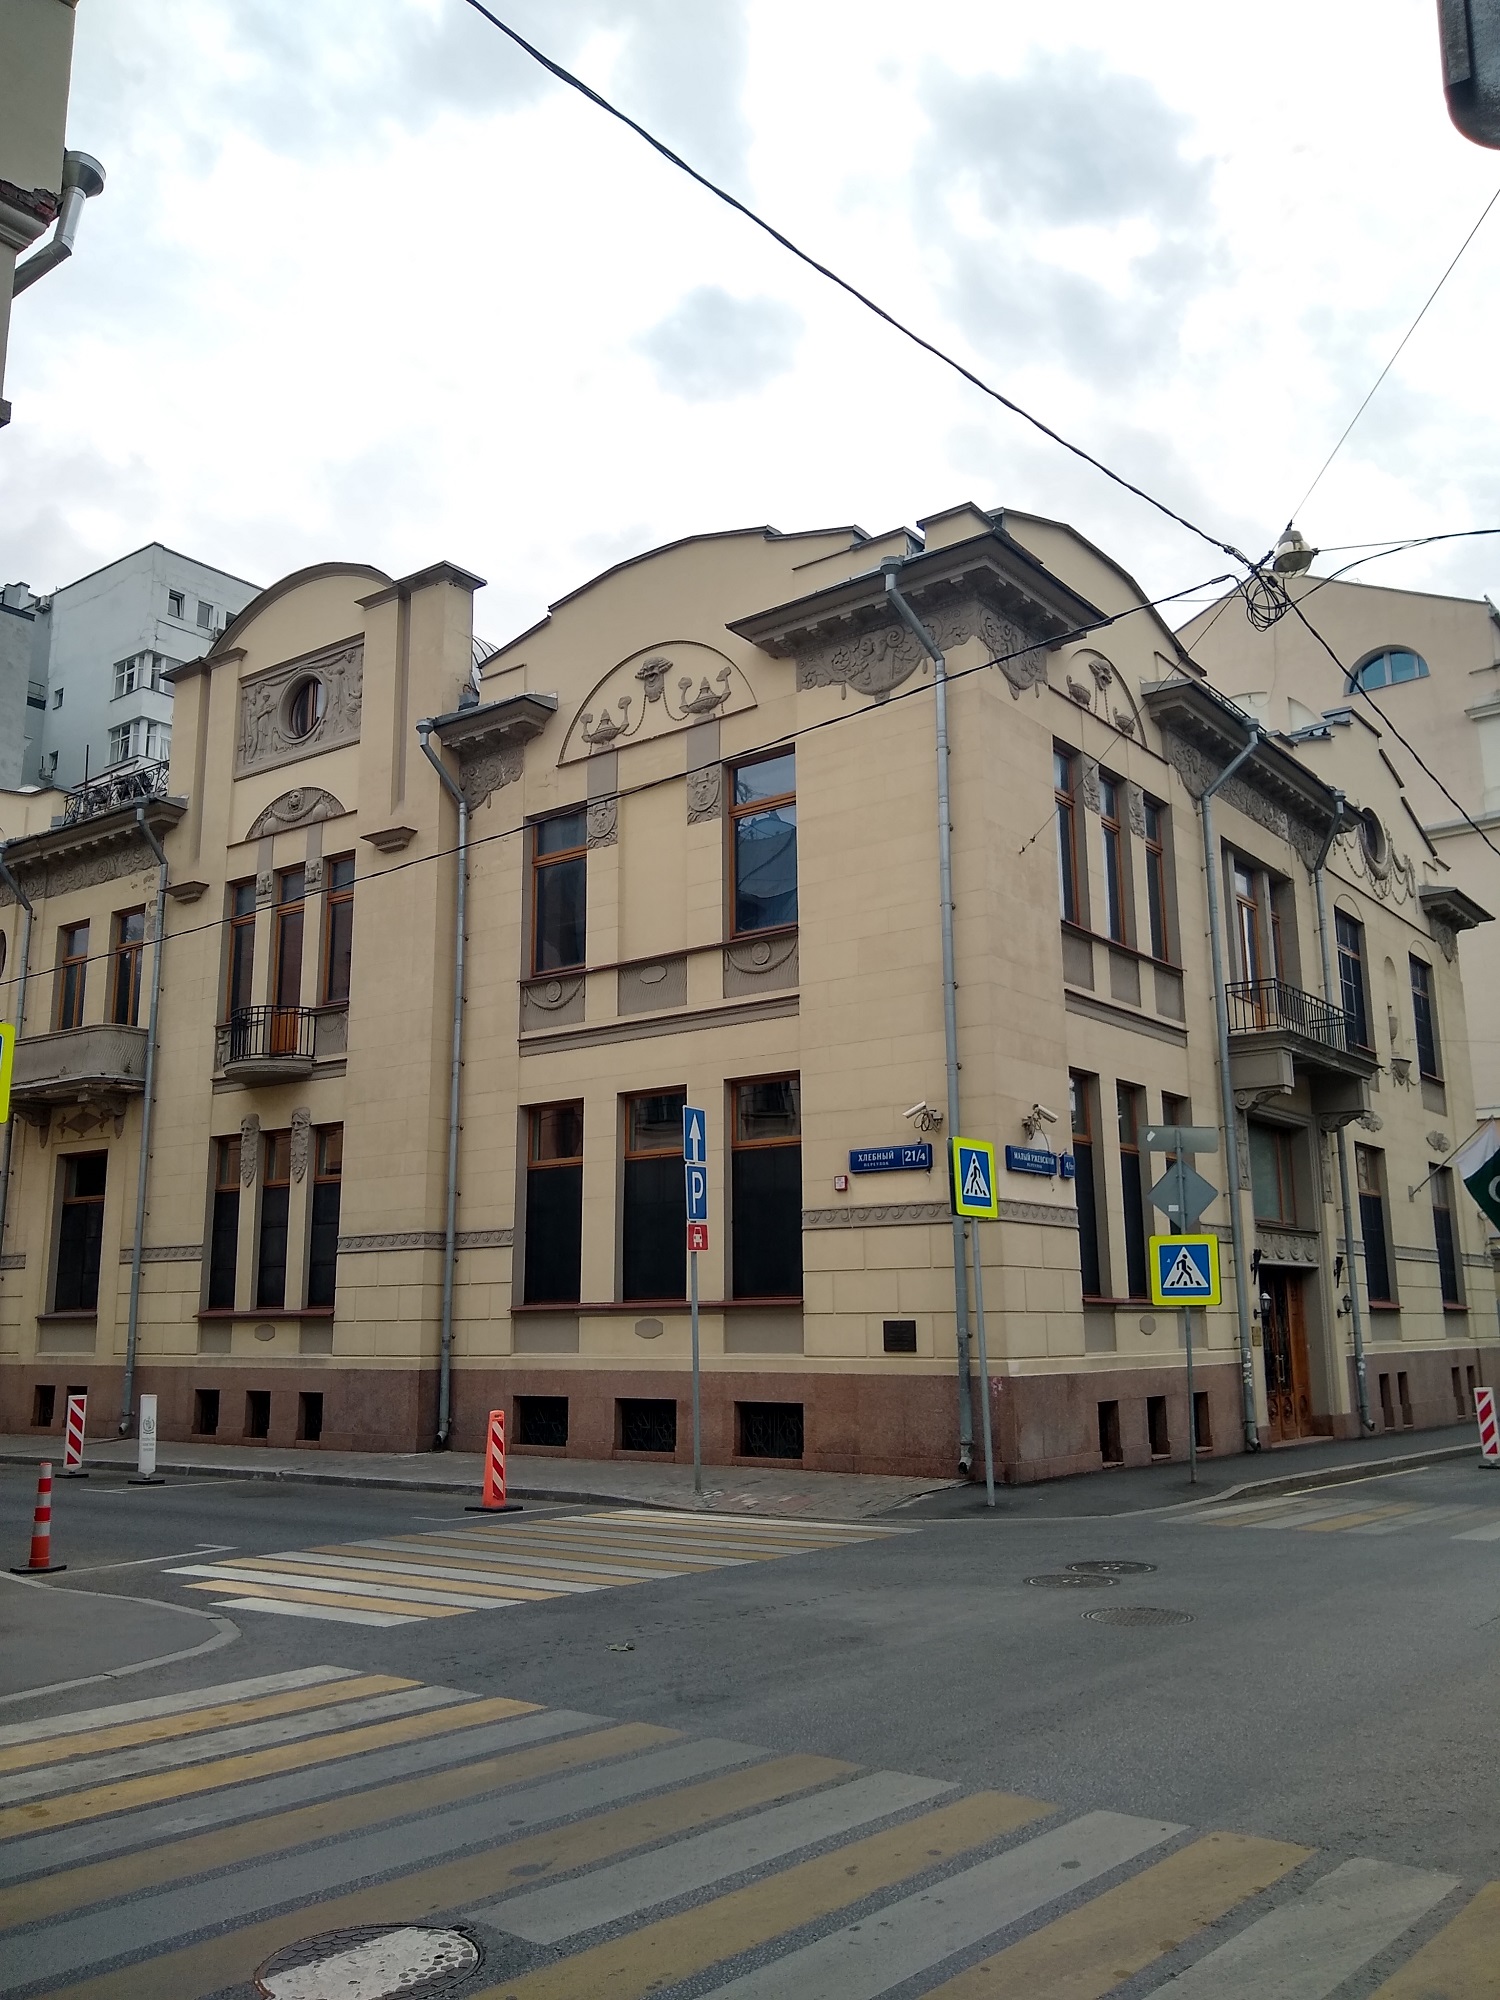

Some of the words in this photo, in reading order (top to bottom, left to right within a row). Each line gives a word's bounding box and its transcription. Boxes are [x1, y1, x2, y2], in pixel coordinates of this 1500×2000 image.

[858, 1151, 894, 1162] ХЛЕБНЫЙ
[905, 1149, 926, 1162] 21/4
[1013, 1152, 1031, 1161] МАЛЫЙ
[692, 1171, 704, 1214] P
